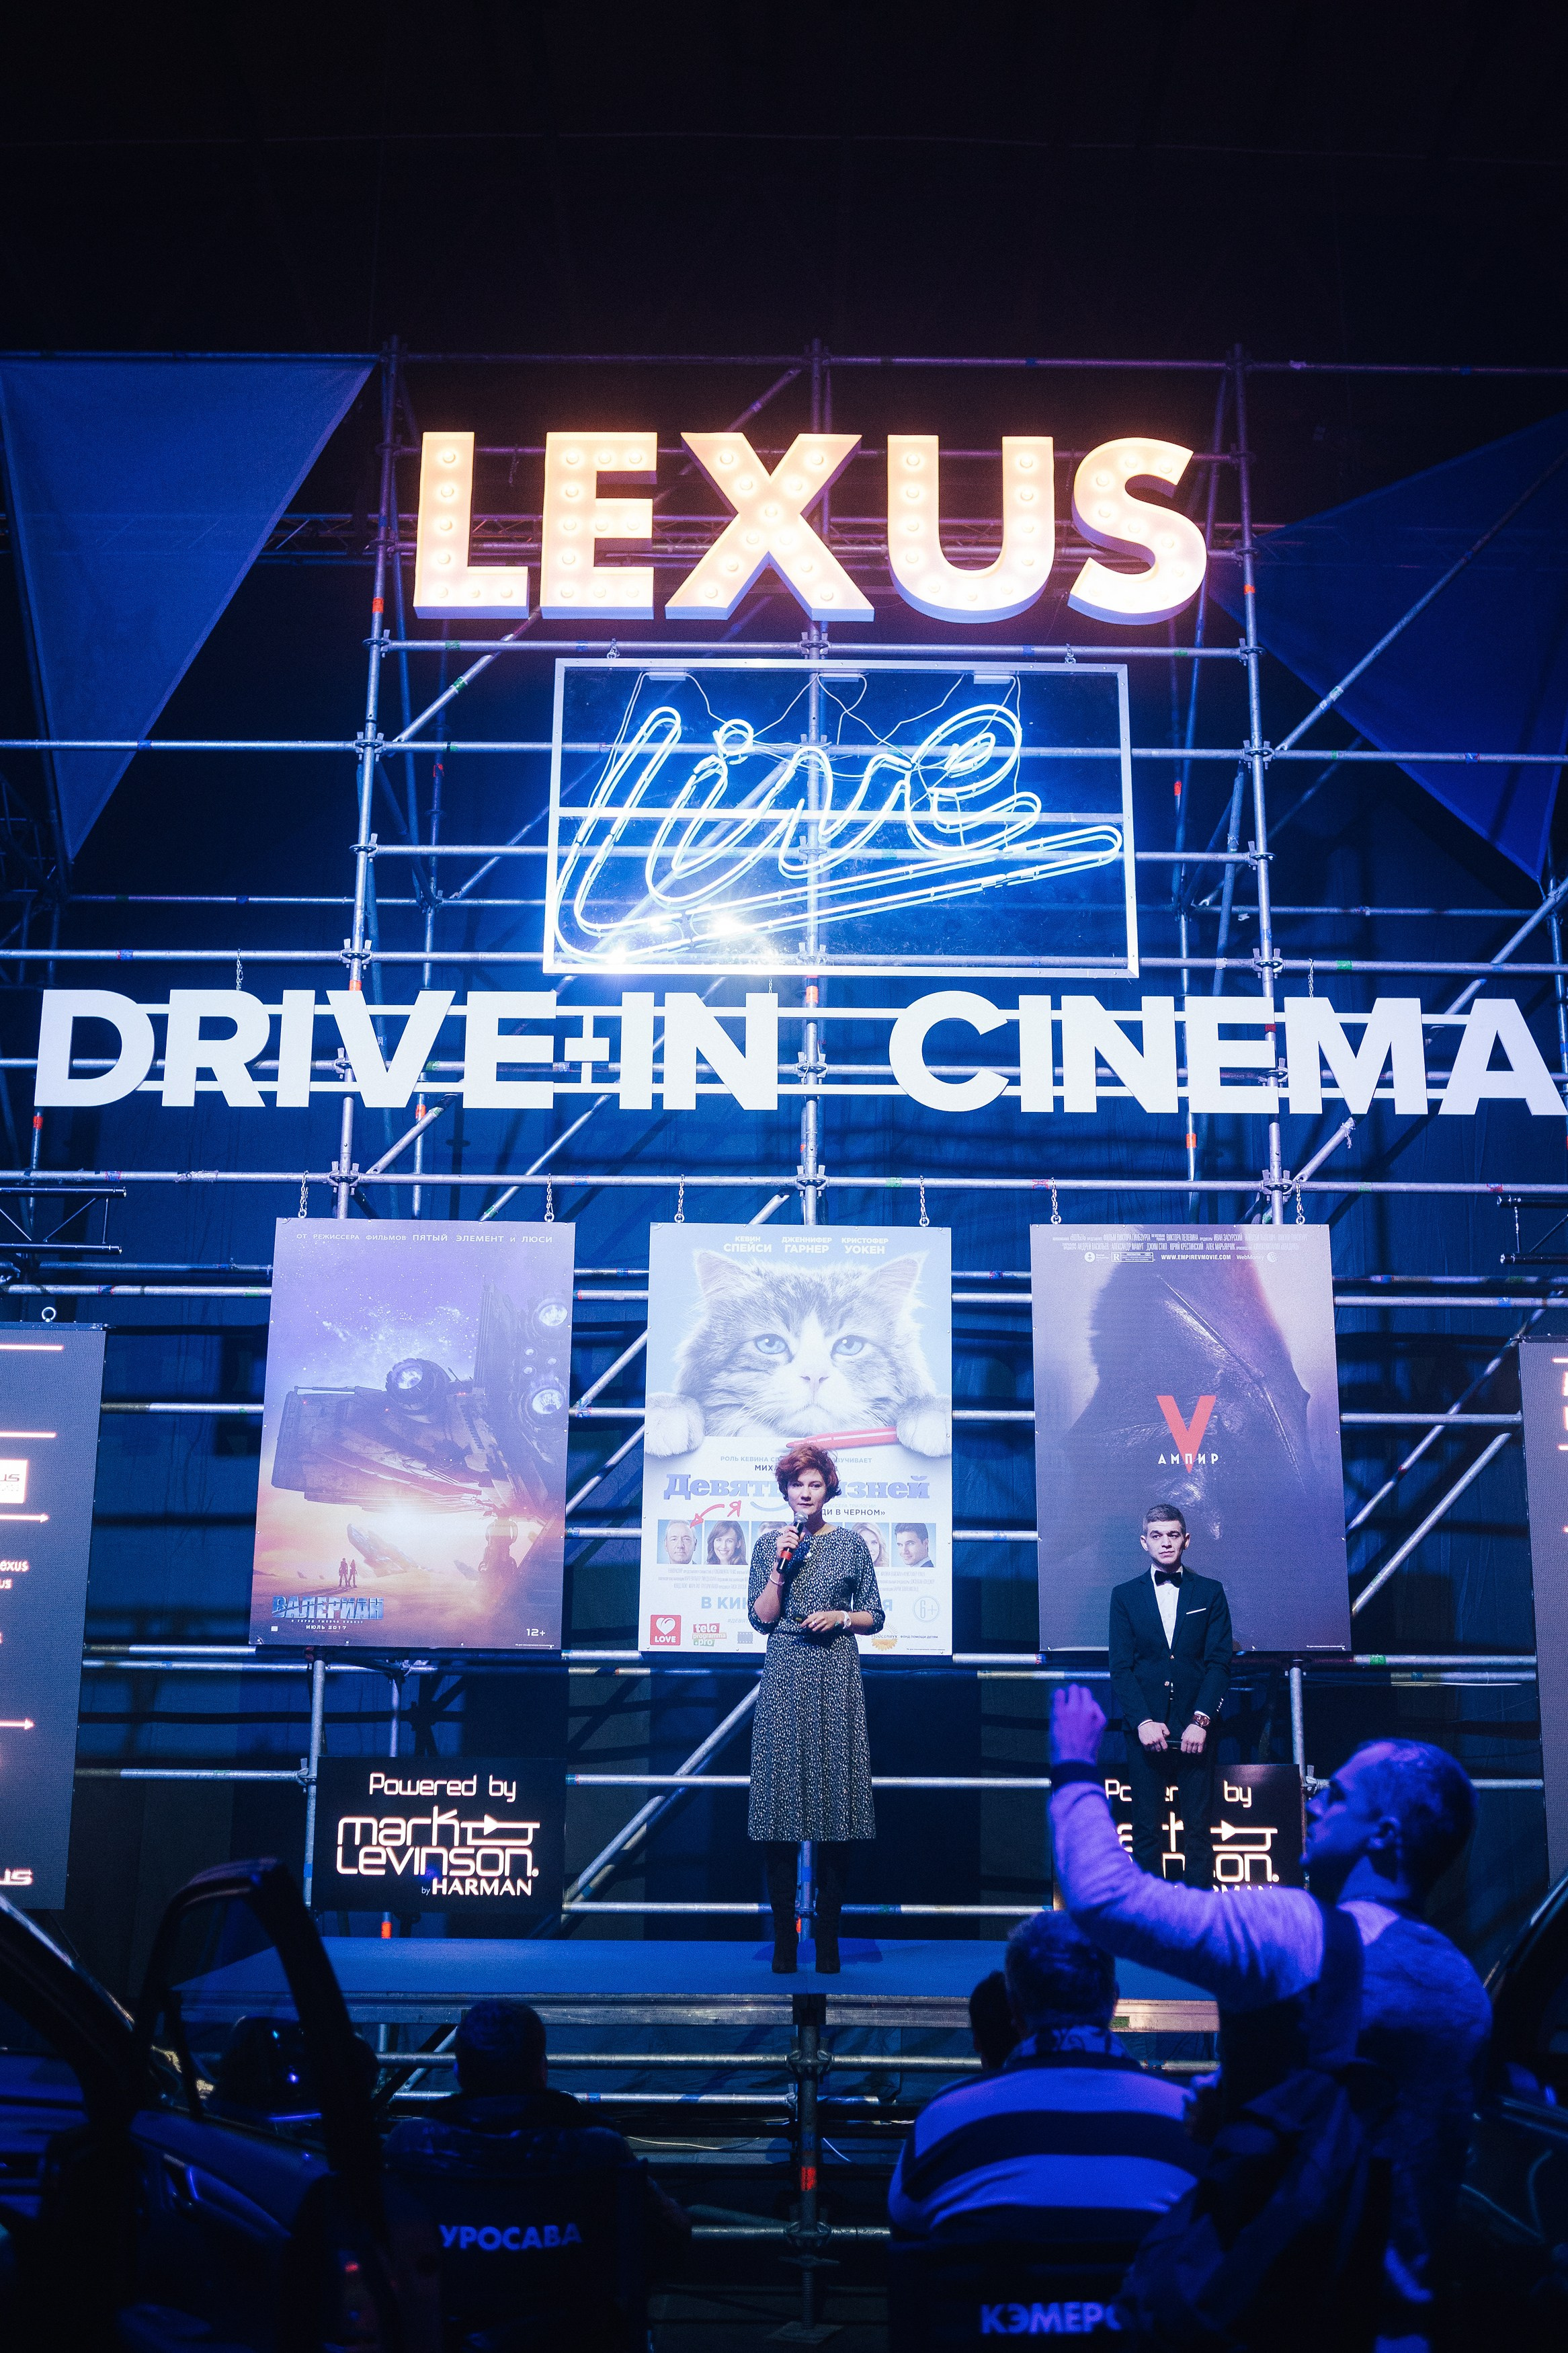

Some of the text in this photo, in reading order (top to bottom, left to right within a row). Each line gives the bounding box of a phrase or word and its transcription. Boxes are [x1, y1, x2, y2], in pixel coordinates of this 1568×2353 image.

[413, 431, 1208, 625] LEXUS
[34, 989, 1568, 1115] DRIVE-IN CINEMA
[413, 1234, 448, 1242] ПЯТЫЙ
[723, 1242, 885, 1254] СПЕЙСИ ГАРНЕР УОКЕН
[1156, 1395, 1217, 1474] V
[1157, 1453, 1219, 1465] АМПИР
[837, 1475, 930, 1499] зней
[727, 1500, 742, 1517] Я
[0, 1560, 30, 1572] exus
[272, 1595, 384, 1620] ВАЛЕРИАН
[701, 1596, 747, 1609] В КИ
[920, 1599, 938, 1619] 6+
[526, 1628, 546, 1636] 12+
[695, 1624, 718, 1633] tele
[654, 1635, 677, 1643] LOVE
[369, 1772, 517, 1803] Powered by
[1223, 1780, 1253, 1808] by
[421, 1878, 532, 1897] by HARMAN
[439, 2222, 583, 2251] УРОСАВА
[980, 2301, 1122, 2335] КЭМЕР
